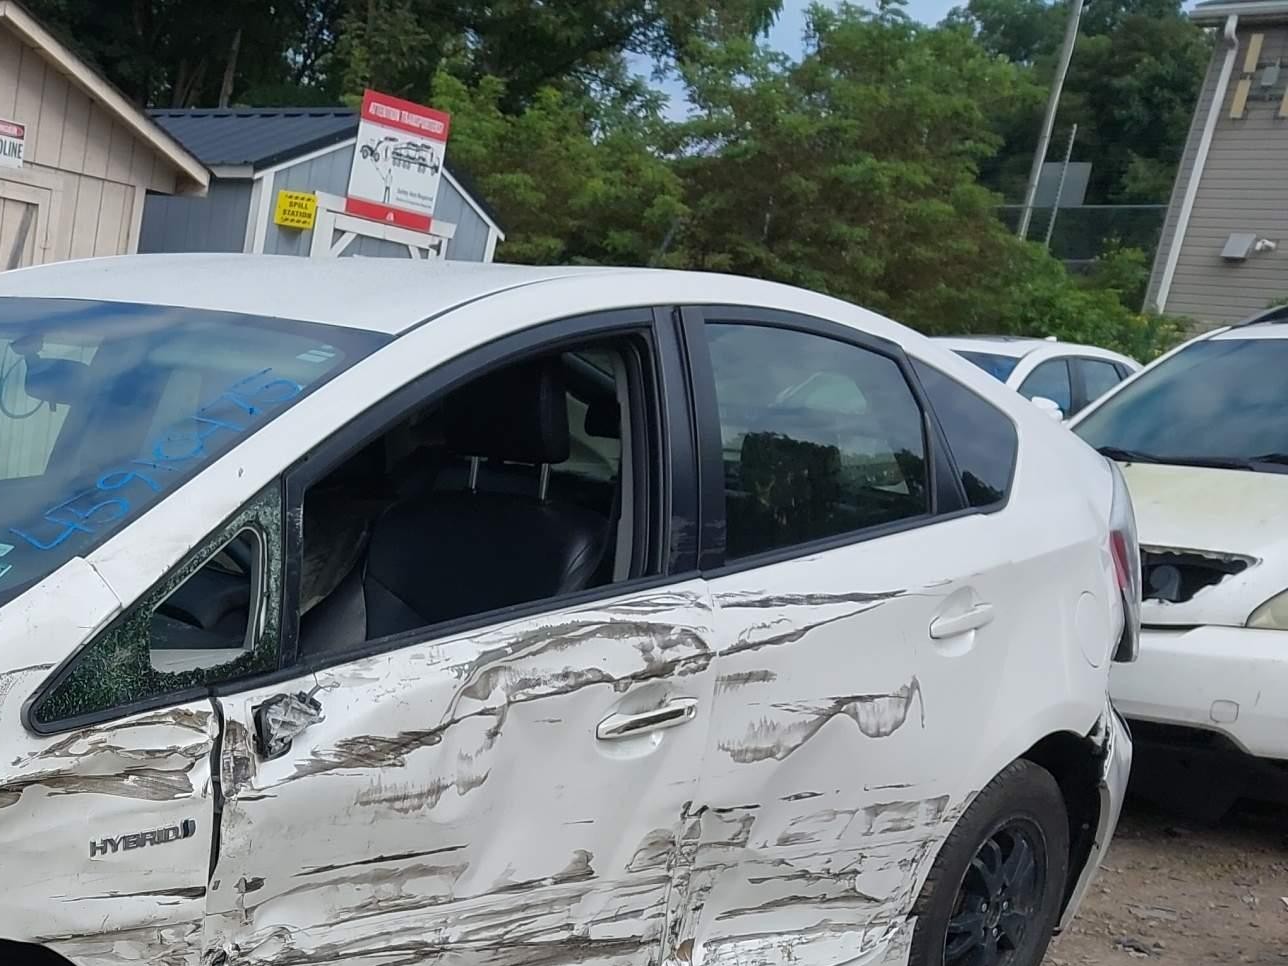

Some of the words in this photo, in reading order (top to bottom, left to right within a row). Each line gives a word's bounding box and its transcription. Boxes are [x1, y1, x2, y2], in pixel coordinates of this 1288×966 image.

[288, 200, 309, 211] SPILL
[282, 208, 313, 220] STATION
[89, 826, 180, 858] HYBRID
